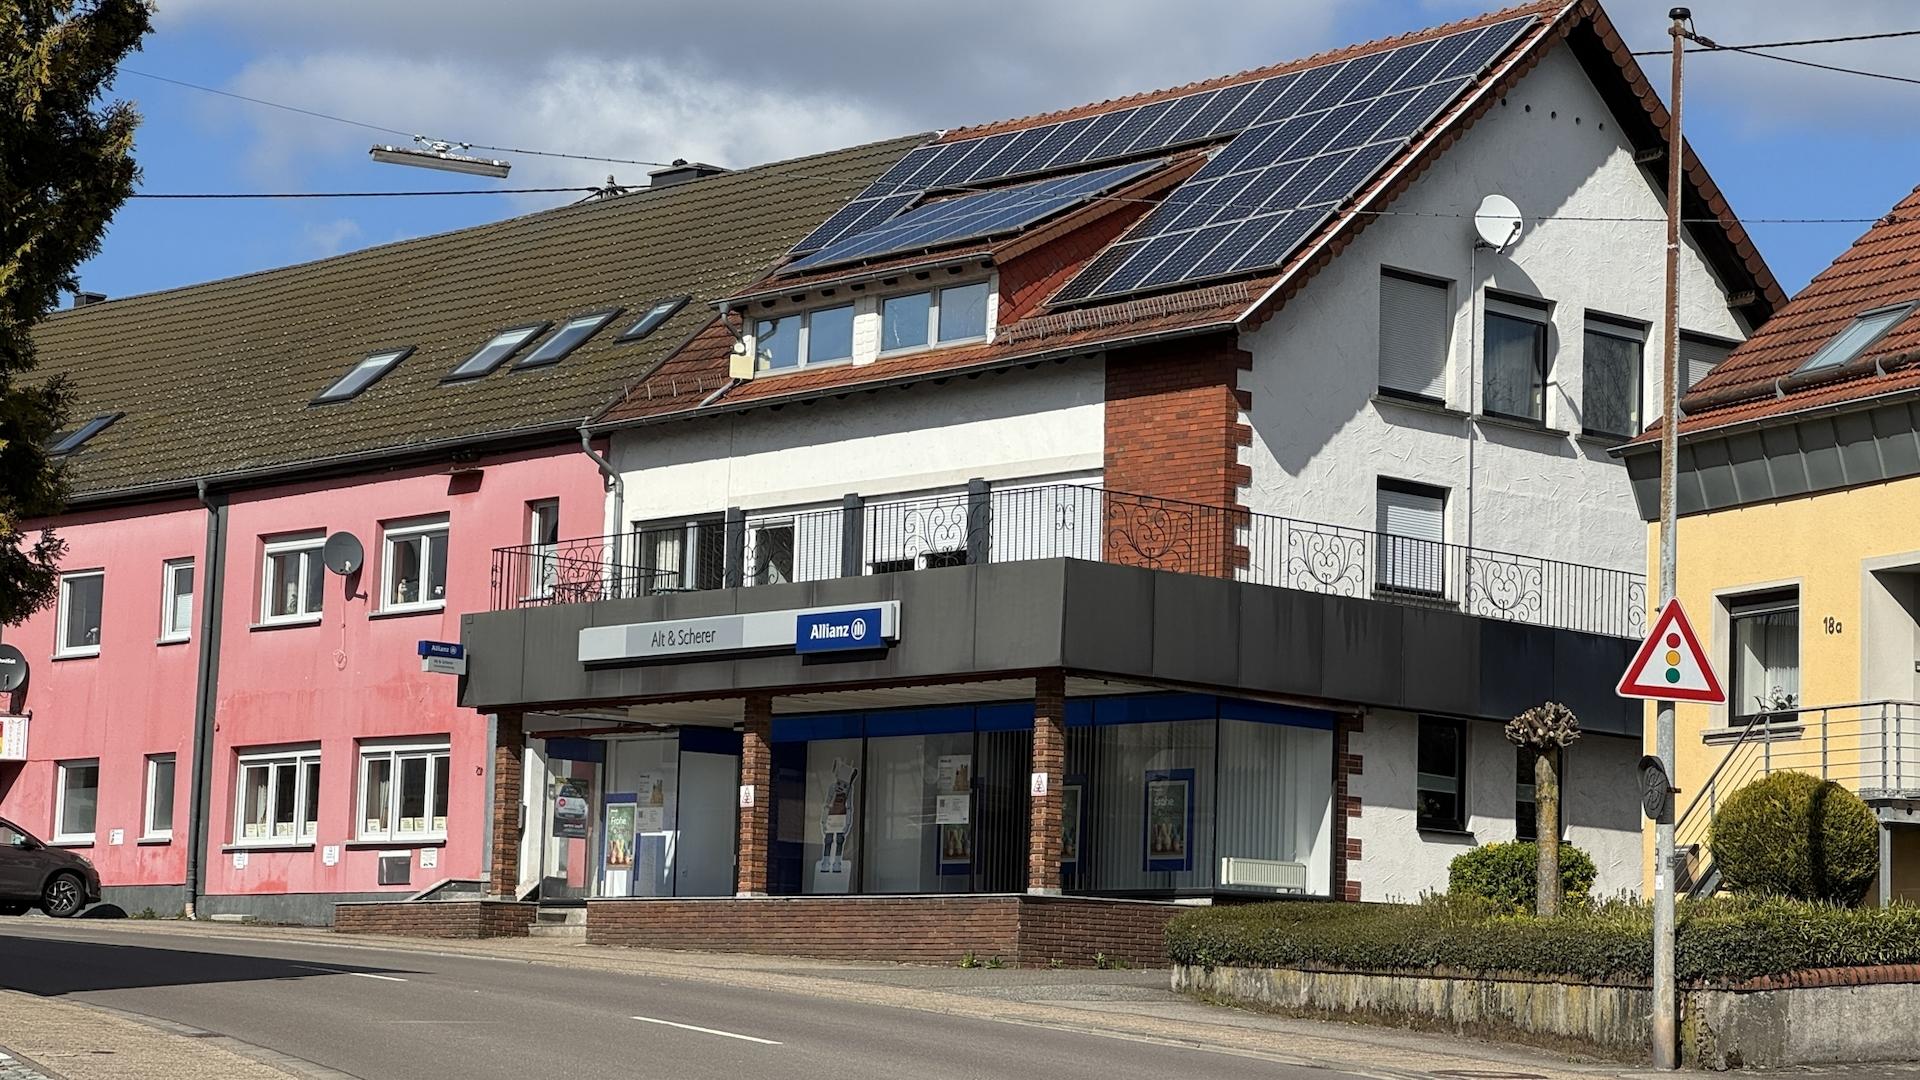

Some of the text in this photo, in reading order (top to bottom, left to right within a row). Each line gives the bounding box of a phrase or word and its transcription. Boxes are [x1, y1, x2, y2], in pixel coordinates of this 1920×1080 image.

[810, 623, 849, 640] Allianz
[1823, 616, 1843, 635] 18a
[651, 628, 717, 648] Alt & Scherer
